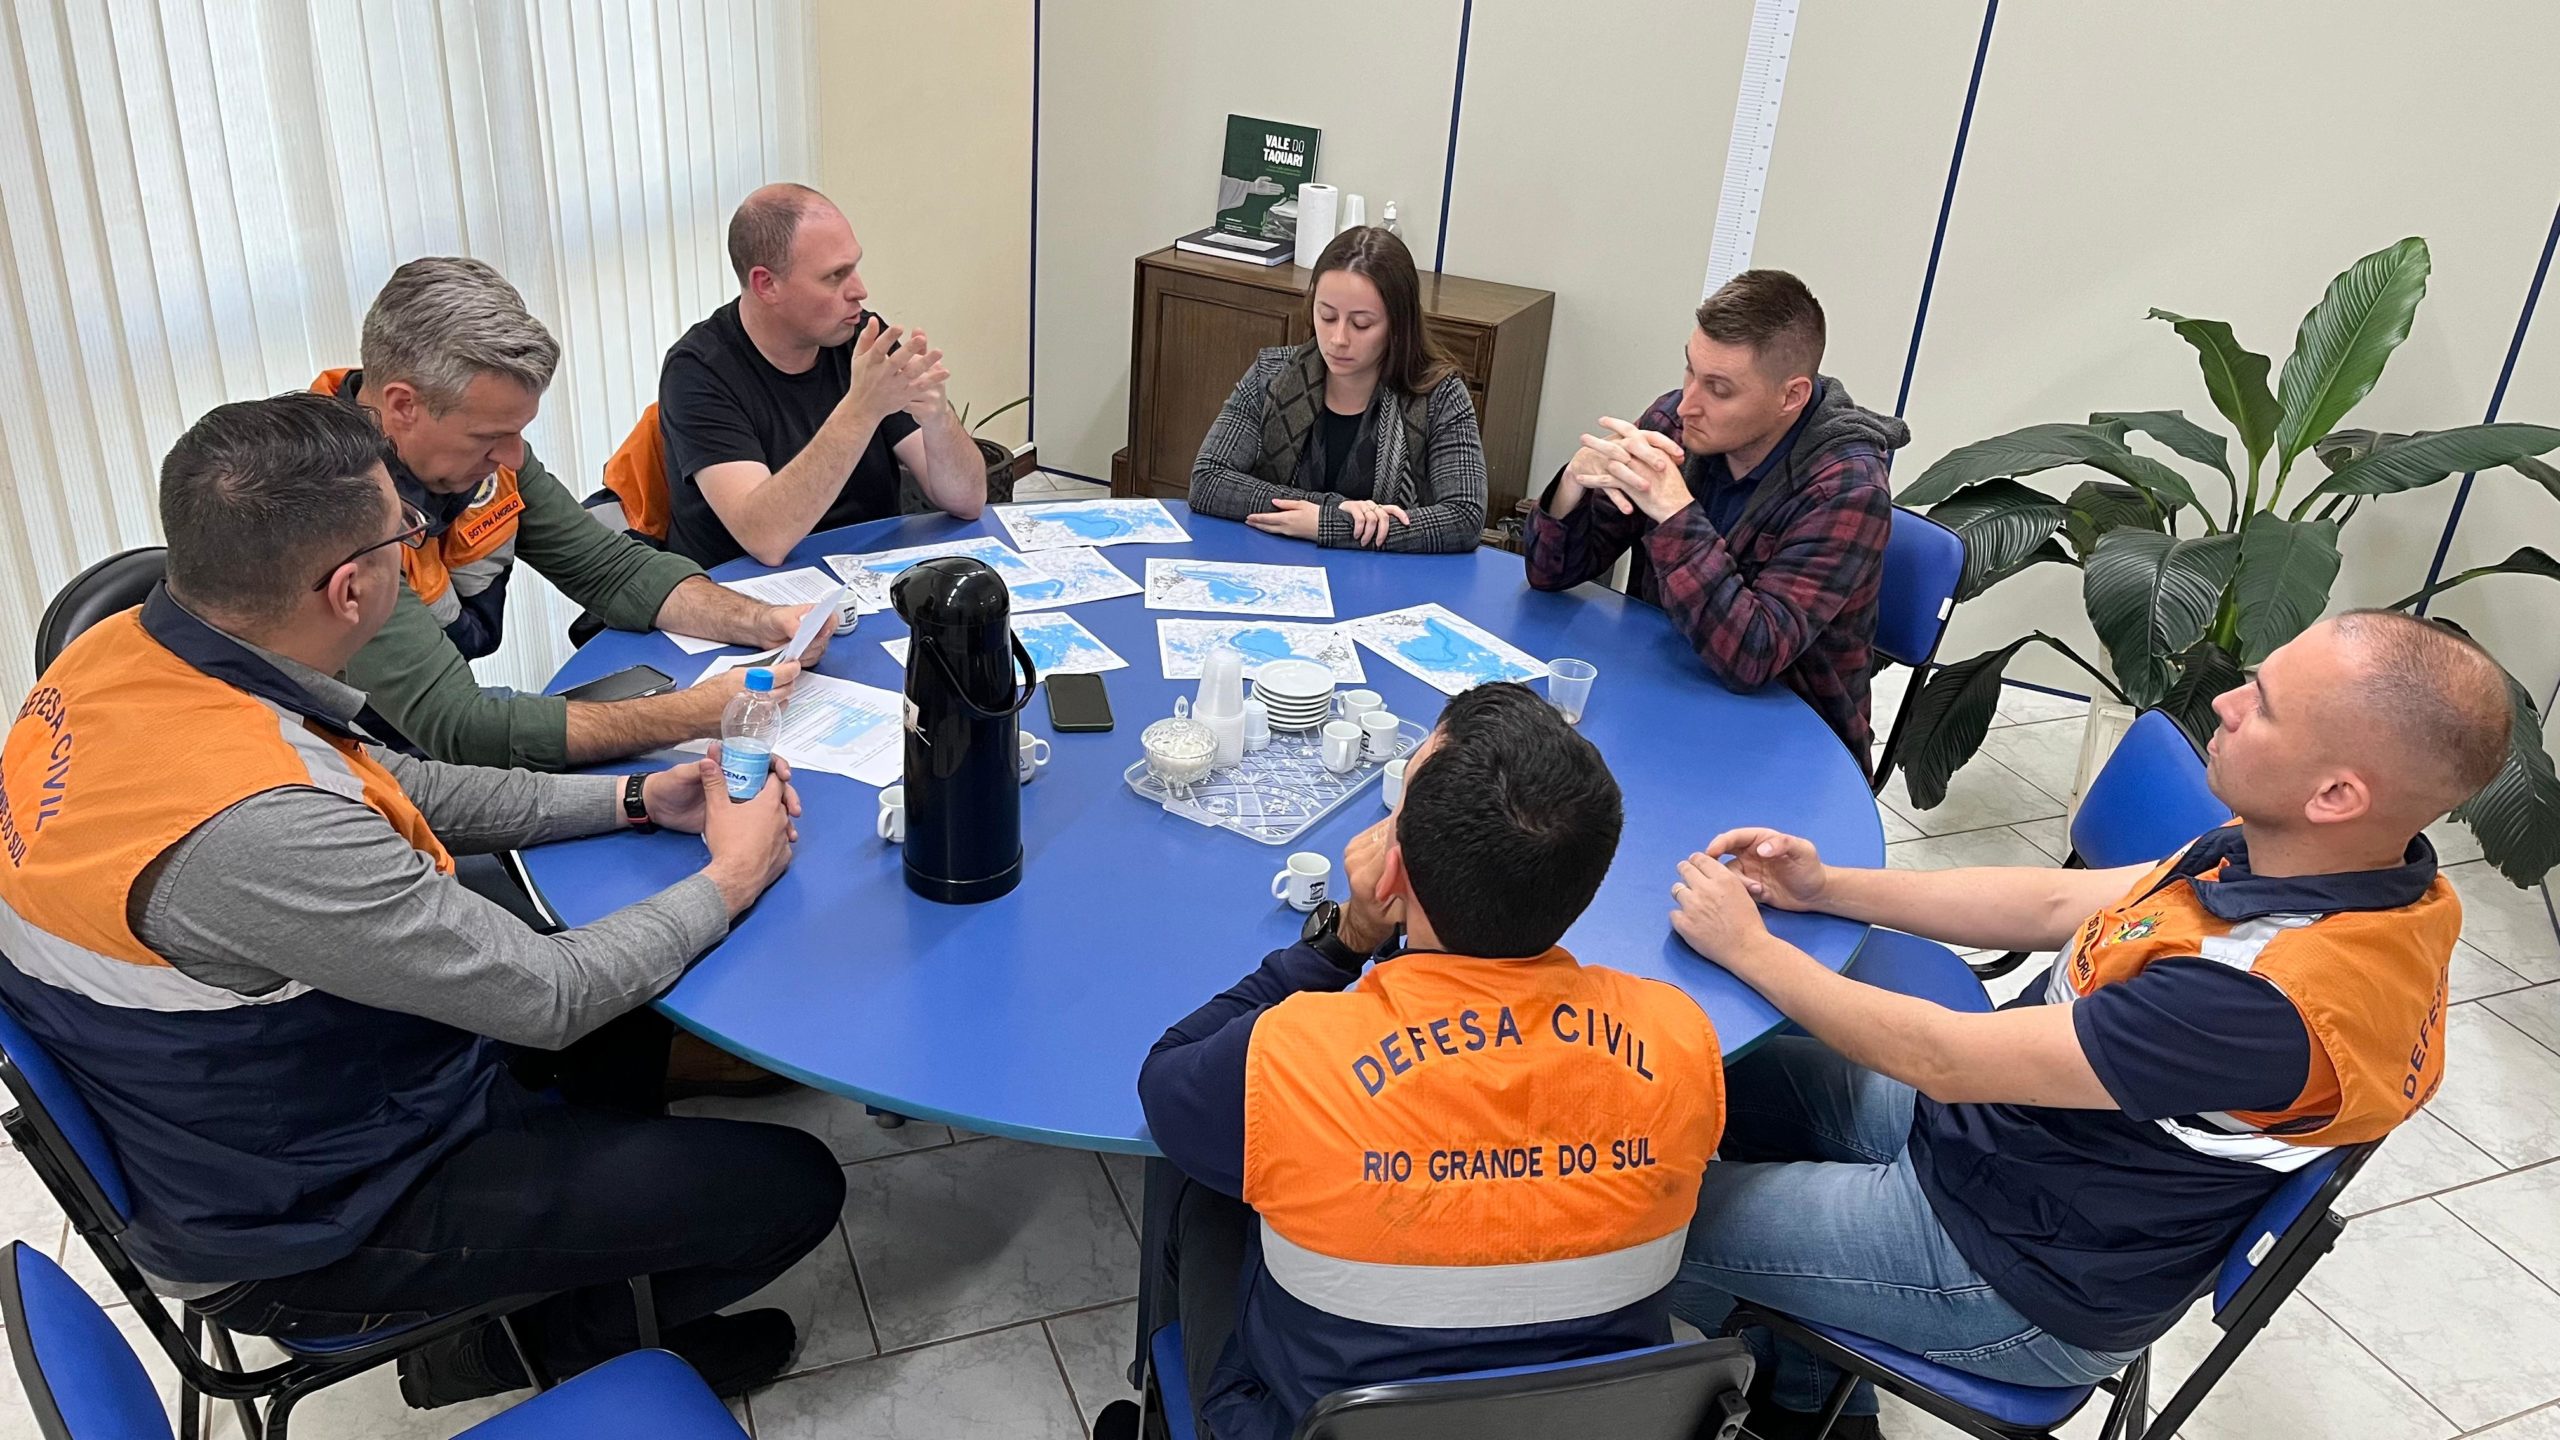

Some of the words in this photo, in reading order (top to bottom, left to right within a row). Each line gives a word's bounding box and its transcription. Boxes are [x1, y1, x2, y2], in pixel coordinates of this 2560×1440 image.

[1263, 148, 1304, 168] TAQUARI
[1265, 134, 1291, 151] VALE
[1292, 139, 1305, 153] DO
[468, 525, 483, 540] SGT
[35, 733, 73, 832] CIVIL
[8, 831, 27, 868] SUL
[1352, 1005, 1523, 1097] DEFESA
[1551, 1003, 1654, 1082] CIVIL
[1363, 1150, 1412, 1182] RIO
[1428, 1146, 1543, 1181] GRANDE
[1558, 1143, 1597, 1176] DO
[1612, 1137, 1656, 1171] SUL
